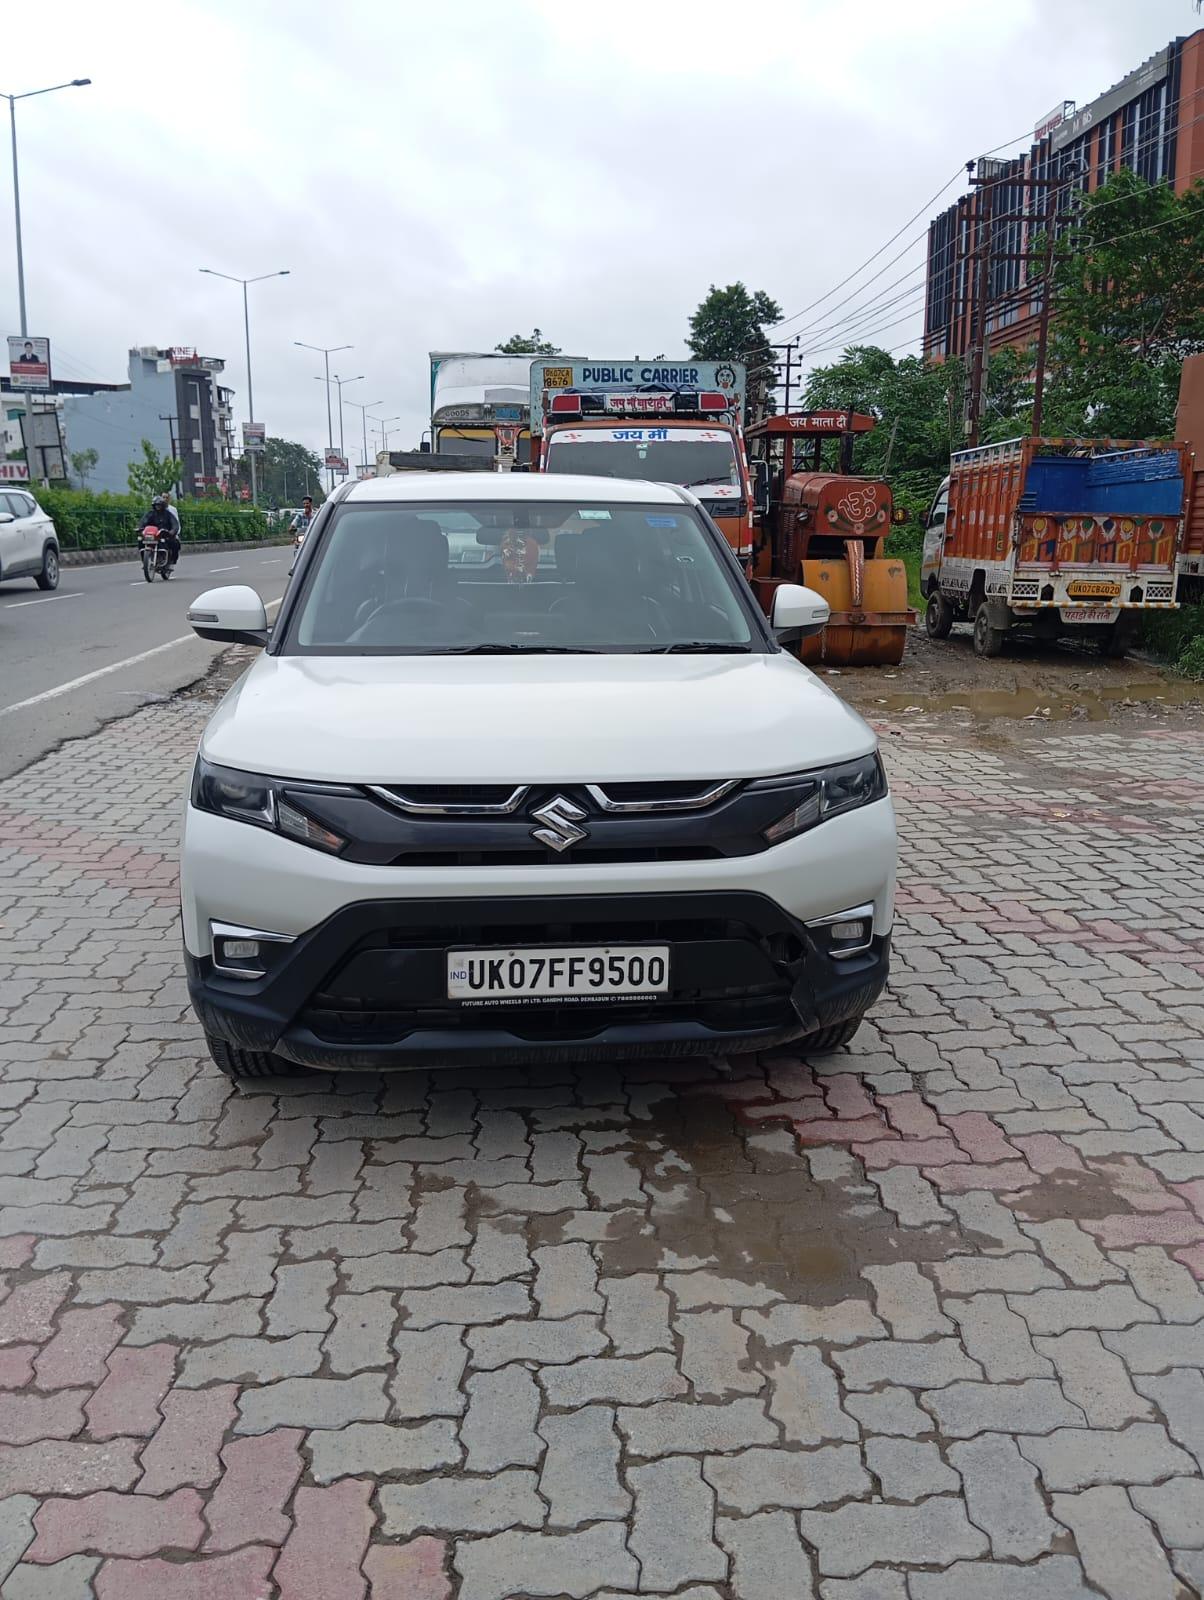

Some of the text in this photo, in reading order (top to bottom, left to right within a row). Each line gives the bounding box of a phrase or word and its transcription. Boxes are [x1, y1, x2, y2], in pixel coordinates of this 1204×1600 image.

[582, 367, 699, 384] PUBLIC CARRIER
[788, 414, 848, 429] जय माता दी
[611, 430, 644, 440] जय
[1073, 584, 1121, 595] UK07CB4020
[450, 970, 467, 980] IND
[468, 956, 665, 990] UK07FF9500
